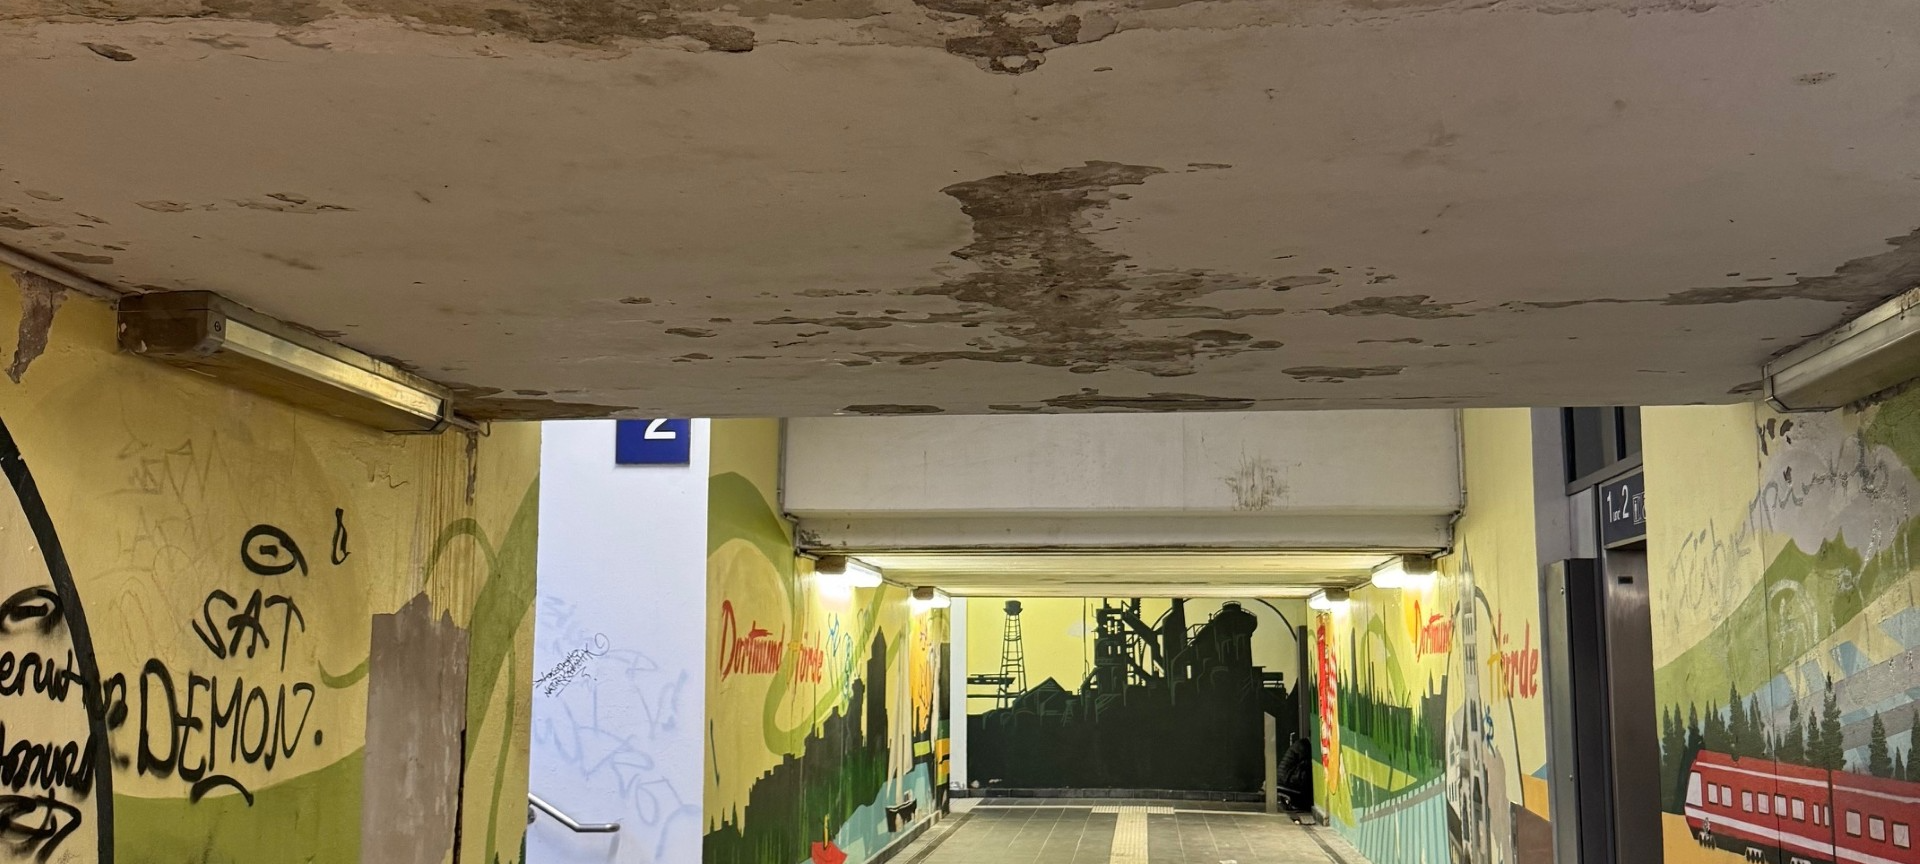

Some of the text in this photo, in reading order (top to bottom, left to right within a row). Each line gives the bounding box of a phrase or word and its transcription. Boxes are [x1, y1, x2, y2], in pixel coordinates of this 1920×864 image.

[1606, 490, 1613, 523] 1
[1621, 484, 1630, 519] 2
[191, 588, 306, 673] SAT
[719, 599, 786, 683] Dortmund
[1413, 599, 1455, 663] Dortmund
